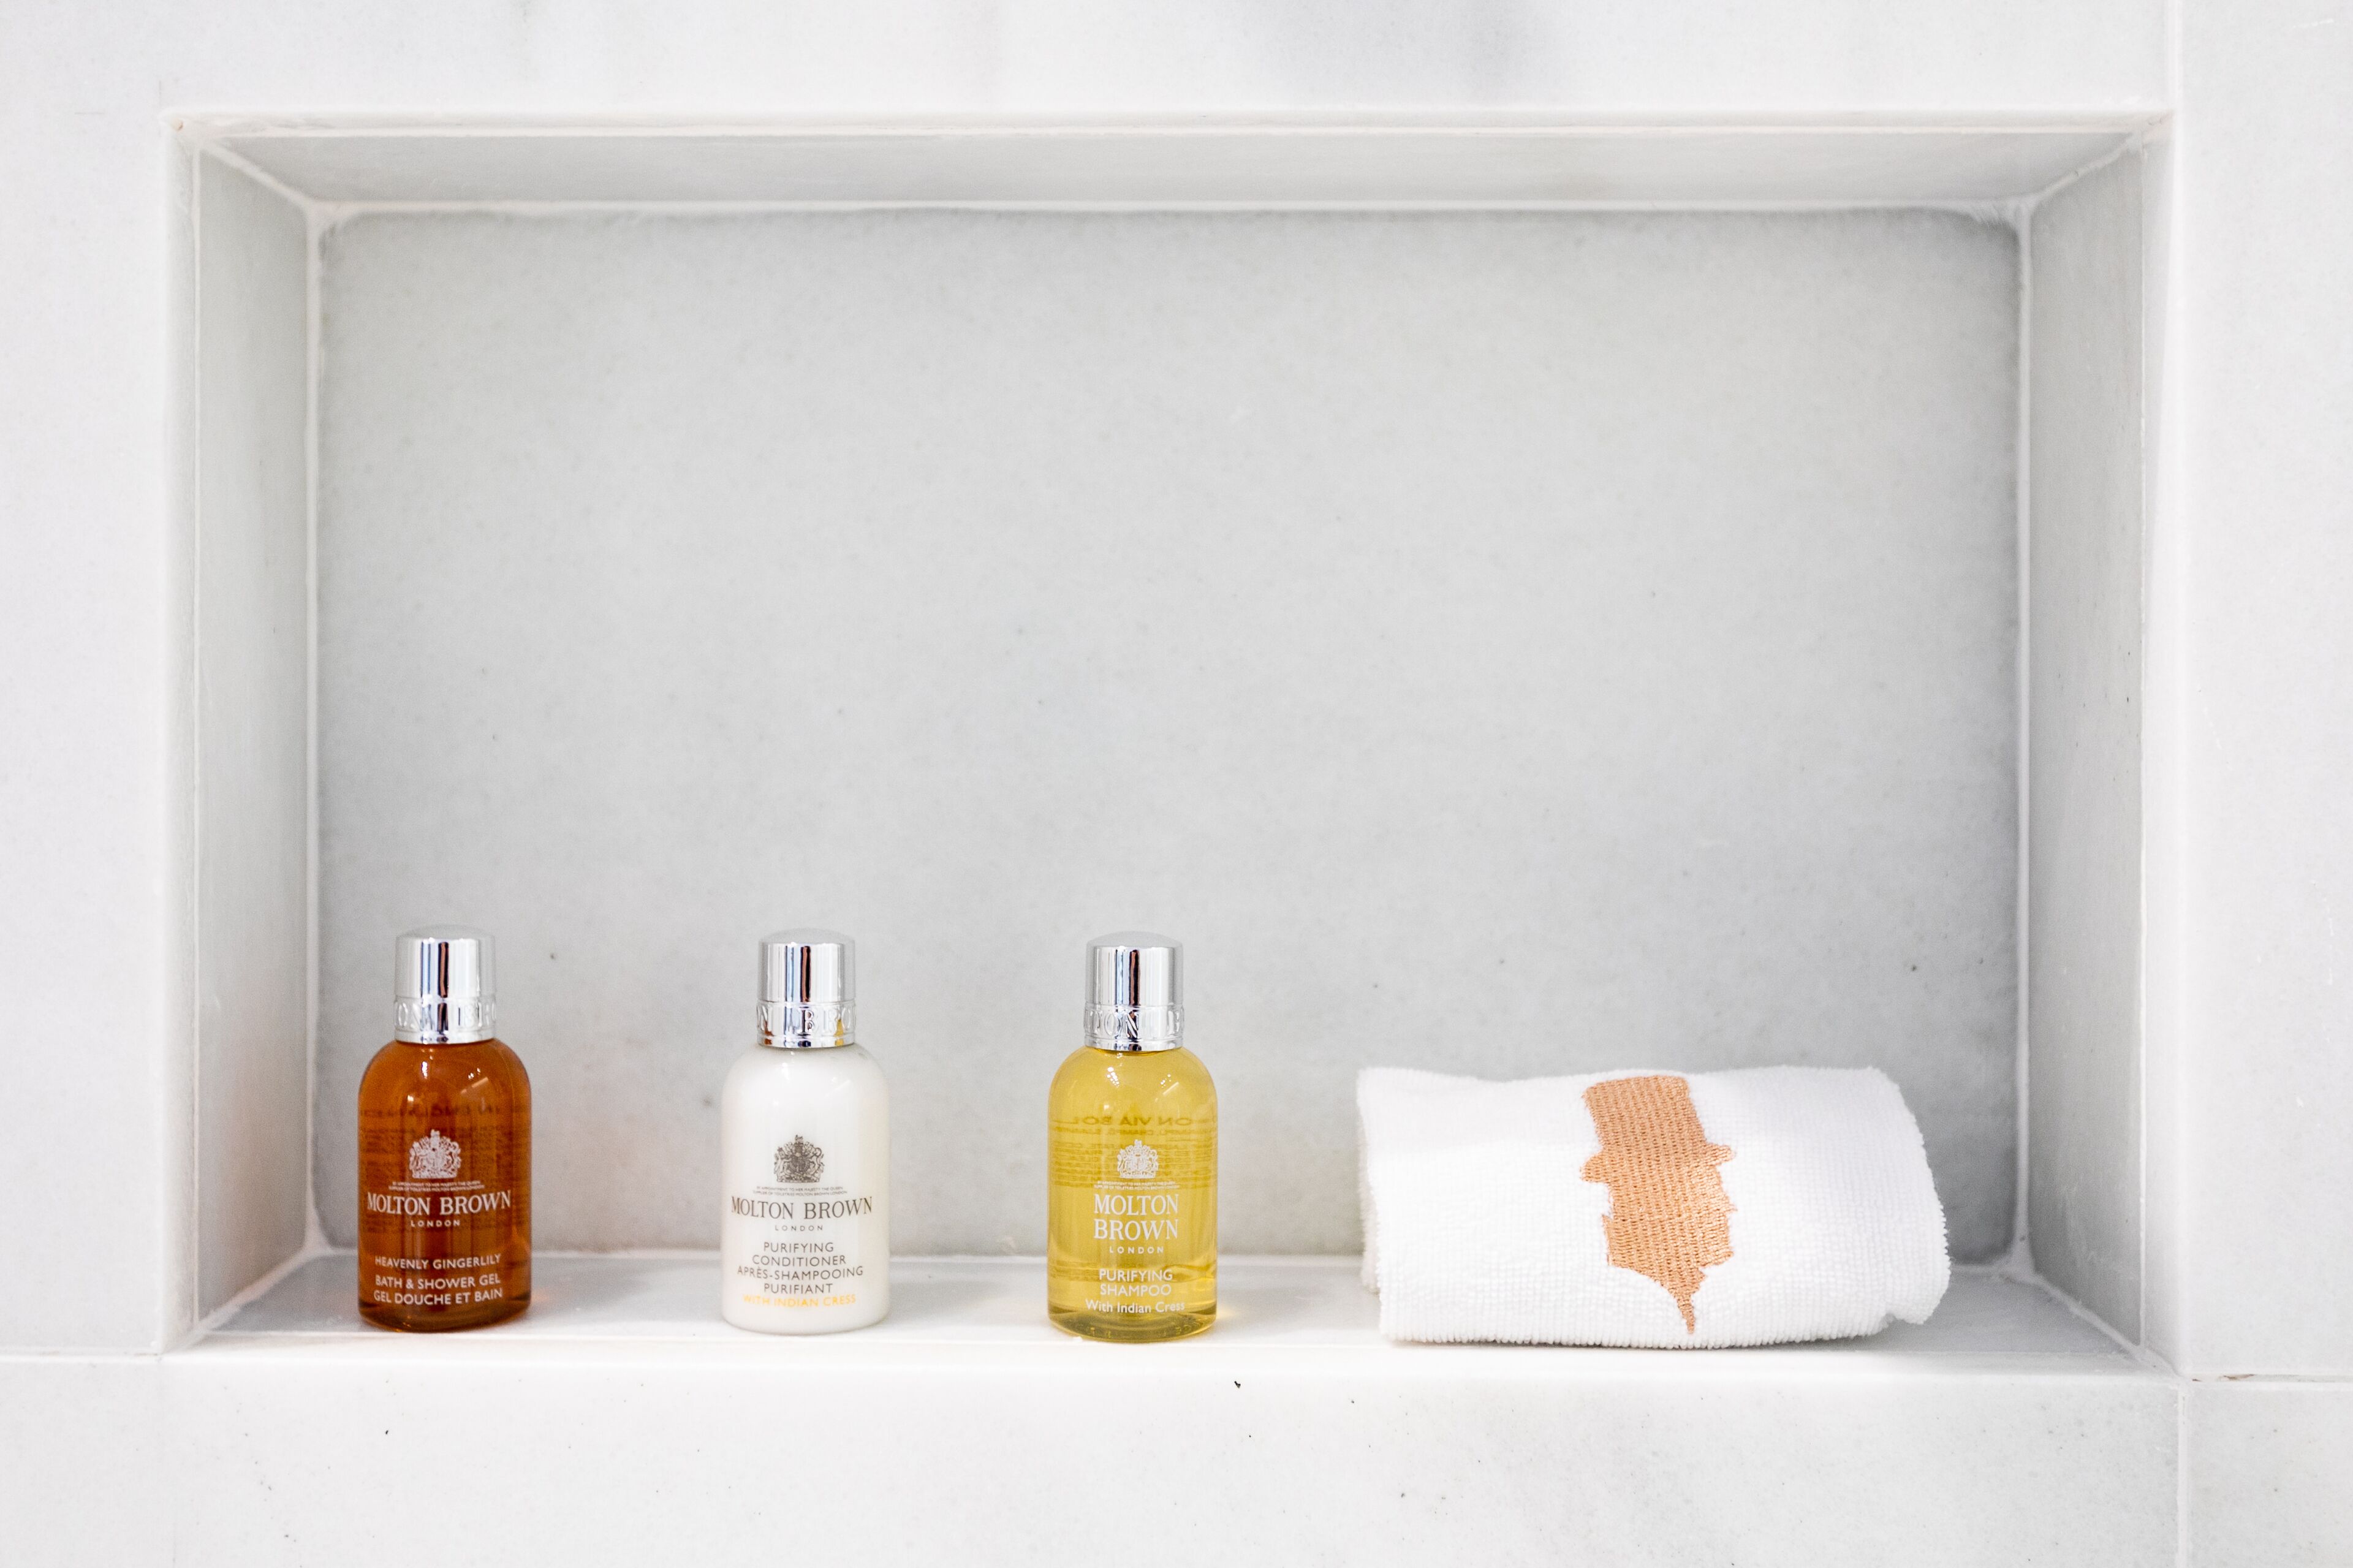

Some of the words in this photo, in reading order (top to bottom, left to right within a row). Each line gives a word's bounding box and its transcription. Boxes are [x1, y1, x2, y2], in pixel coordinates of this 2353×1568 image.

[367, 1192, 431, 1215] MOLTON
[440, 1189, 511, 1215] BROWN
[731, 1195, 794, 1220] MOLTON
[804, 1196, 873, 1220] BROWN
[1094, 1193, 1179, 1216] MOLTON
[1094, 1218, 1179, 1241] BROWN
[763, 1242, 834, 1254] PURIFYING
[375, 1256, 429, 1270] HEAVENLY
[433, 1254, 501, 1270] GINGERLILY
[752, 1254, 846, 1267] CONDITIONER
[737, 1265, 864, 1281] APRÈS-SHAMPOOING
[1099, 1268, 1173, 1282] PURIFYING
[375, 1274, 403, 1289] BATH
[406, 1278, 414, 1290] &
[417, 1276, 476, 1290] SHOWER
[479, 1273, 501, 1286] GEL
[763, 1283, 833, 1295] PURIFIANT
[373, 1290, 392, 1303] GEL
[394, 1292, 452, 1305] DOUCHE
[455, 1292, 471, 1304] ET
[474, 1287, 504, 1303] BAIN
[1100, 1284, 1172, 1297] SHAMPOO
[742, 1293, 770, 1305] WITH
[774, 1298, 819, 1308] INDIAN
[823, 1294, 857, 1307] CRESS
[1085, 1298, 1113, 1312] With
[1117, 1301, 1151, 1314] Indian
[1155, 1301, 1185, 1312] Cress
